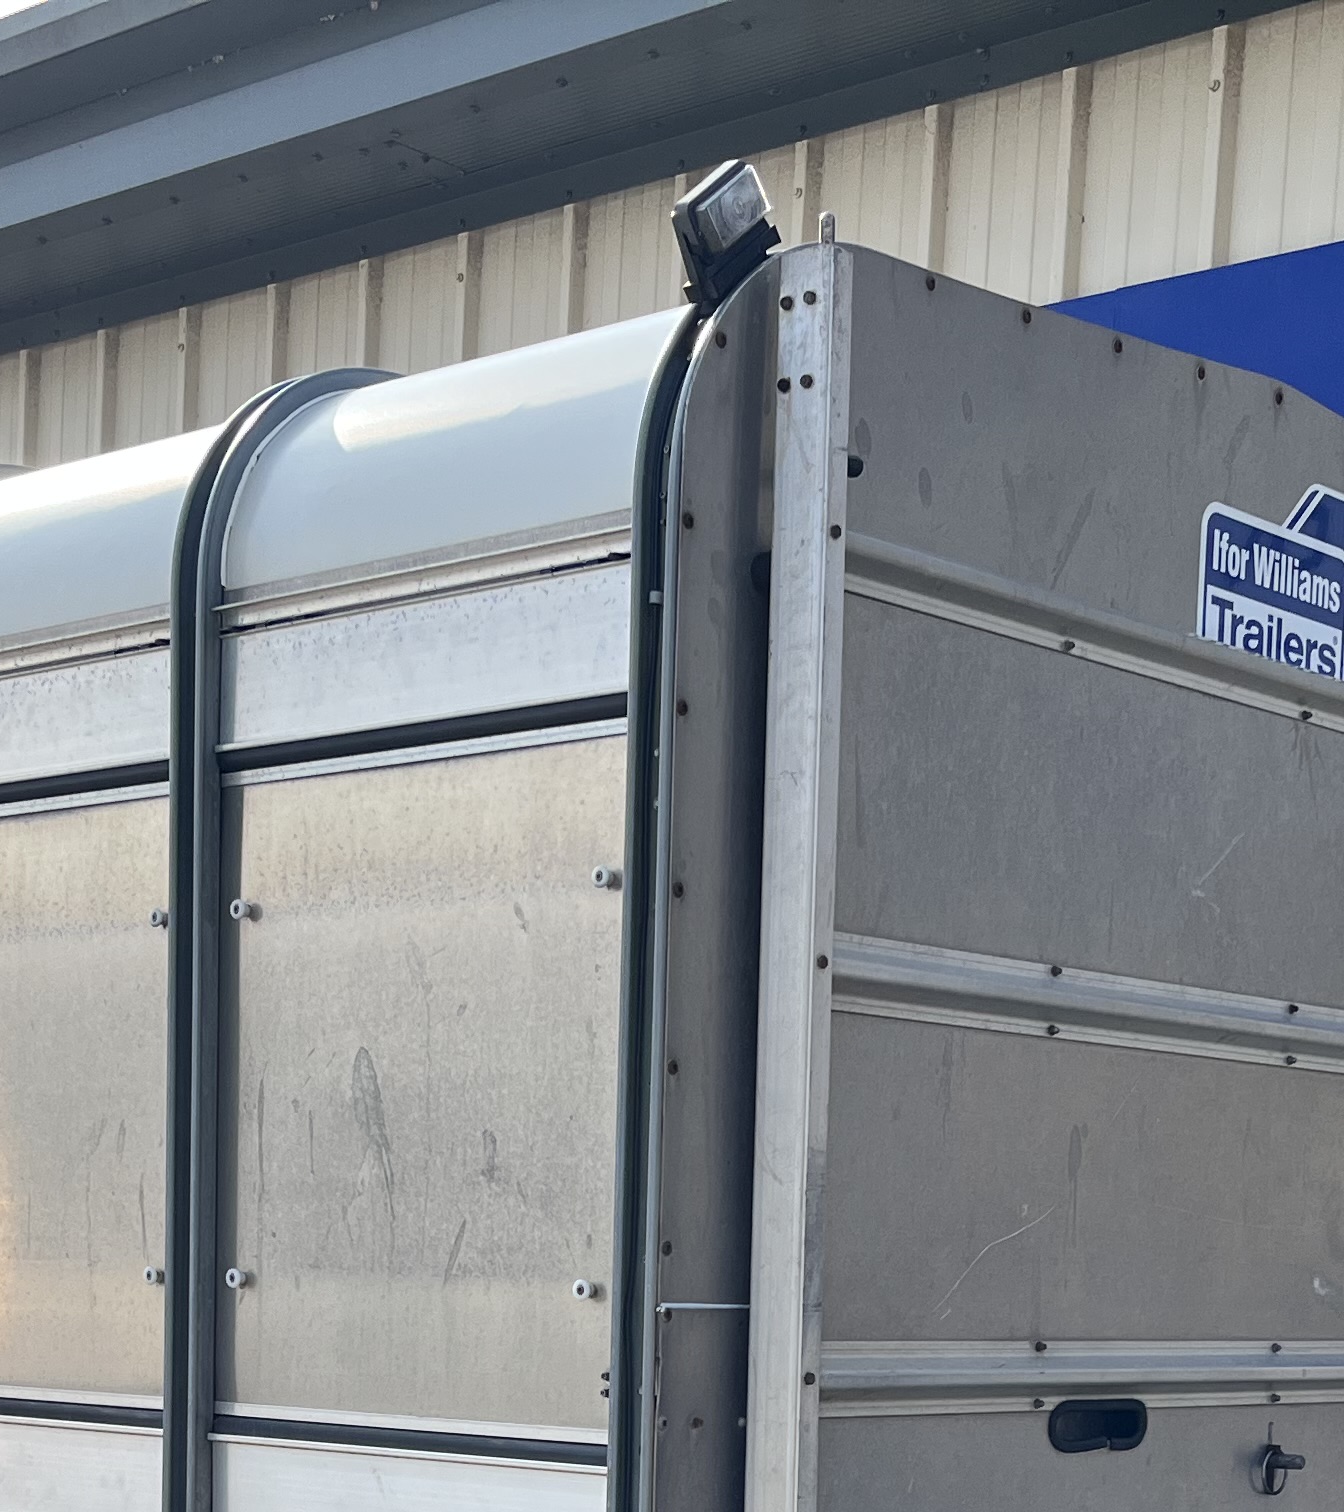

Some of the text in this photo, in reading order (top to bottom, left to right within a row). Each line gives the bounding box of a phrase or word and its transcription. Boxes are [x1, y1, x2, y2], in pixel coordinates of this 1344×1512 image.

[1212, 528, 1341, 612] Ifor Williams
[1211, 595, 1337, 678] Trailers
